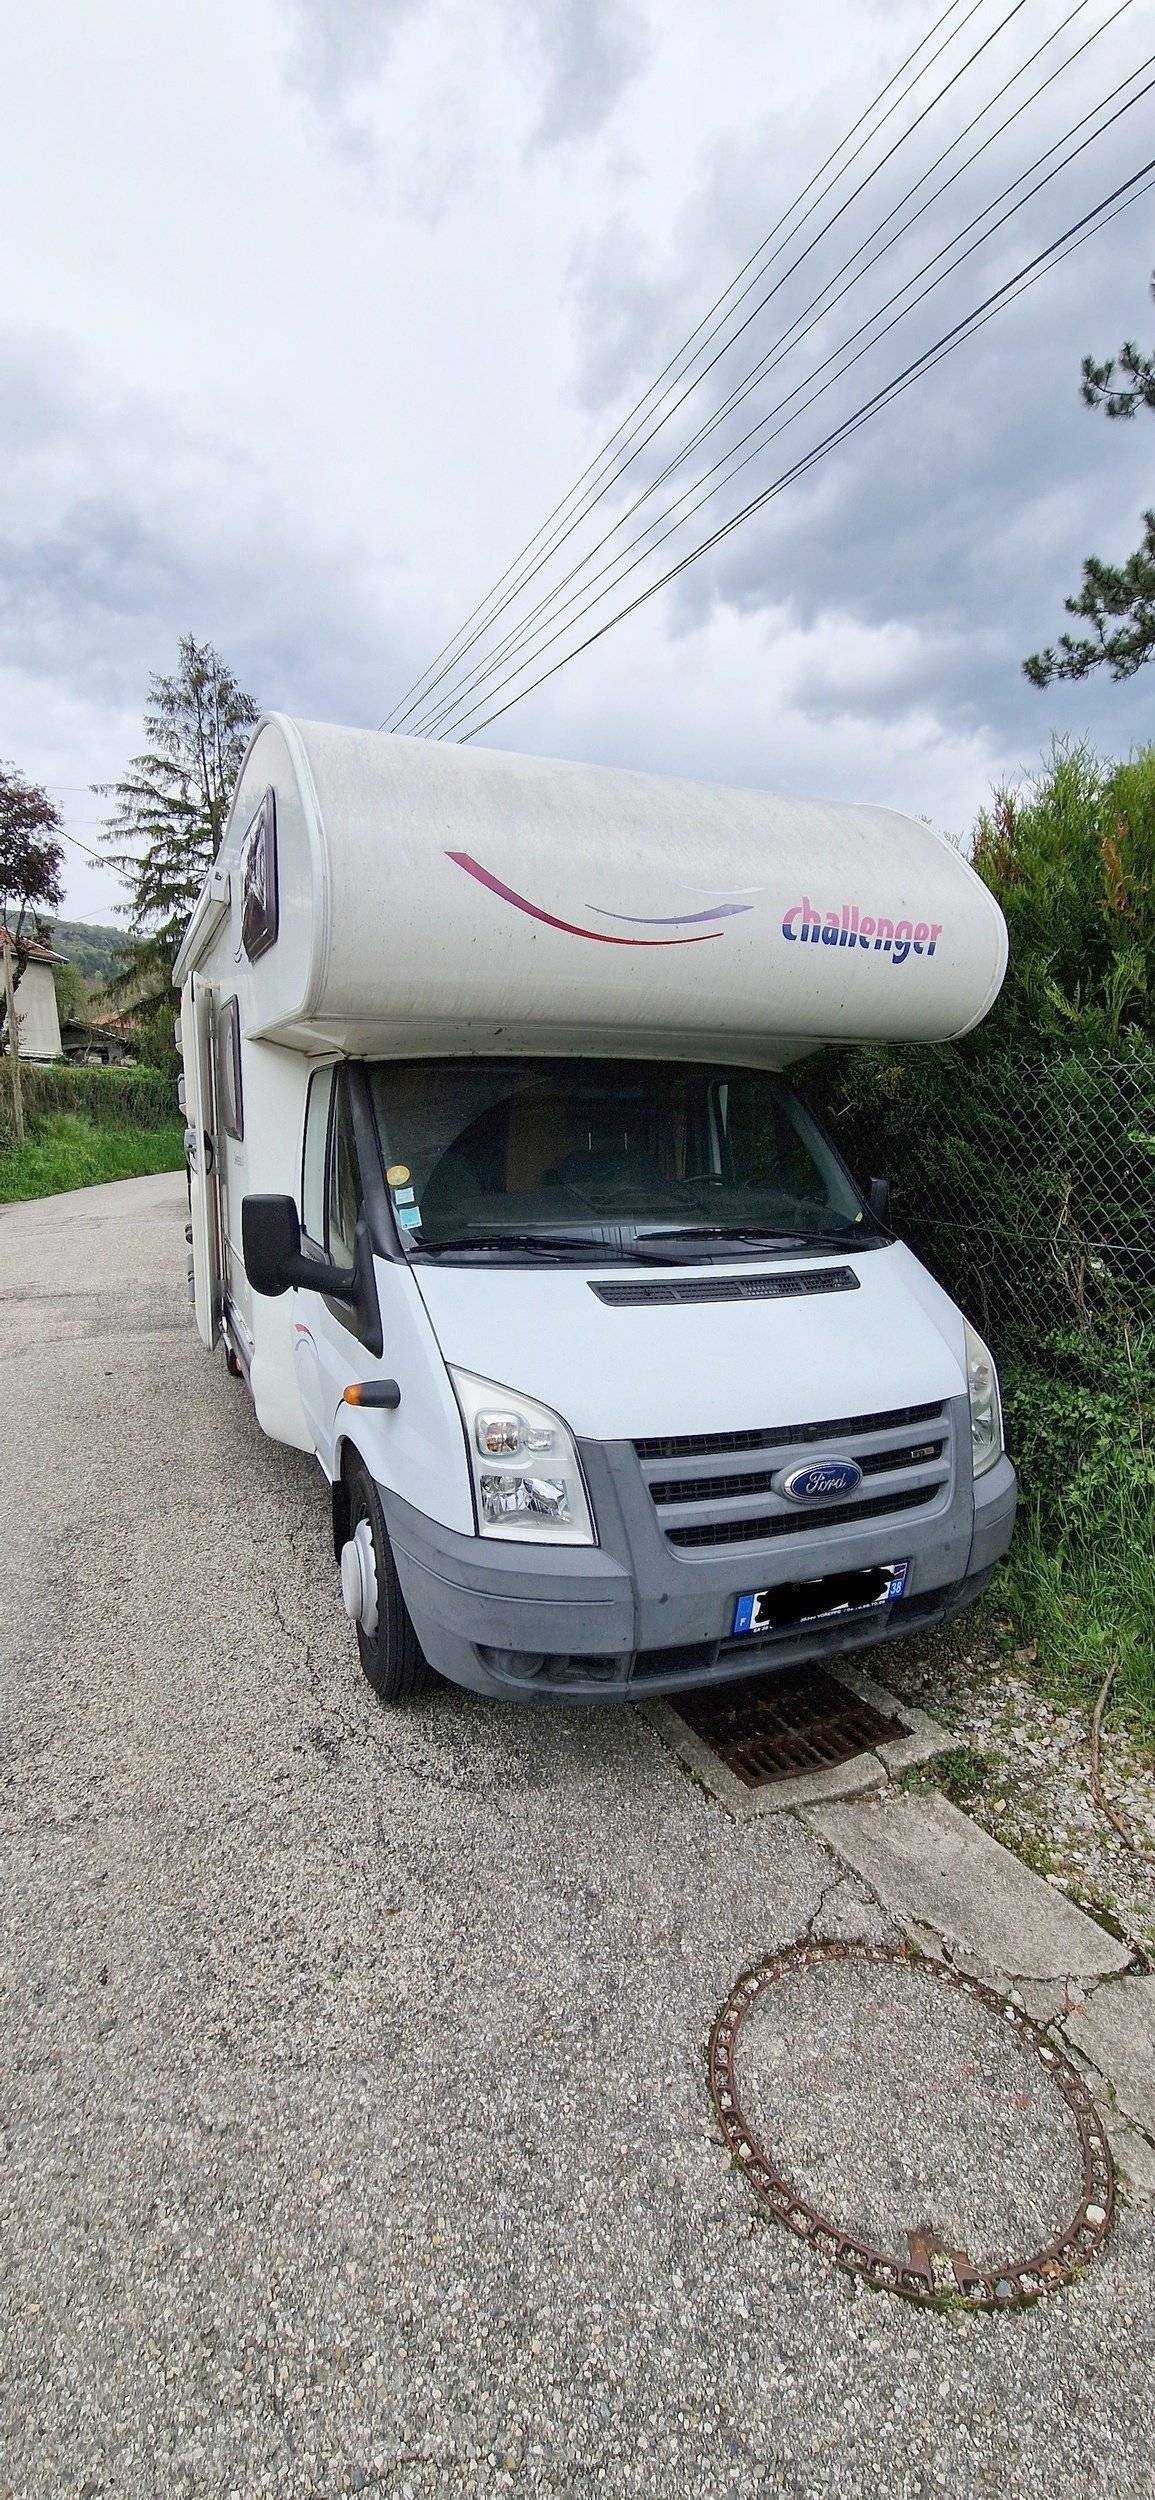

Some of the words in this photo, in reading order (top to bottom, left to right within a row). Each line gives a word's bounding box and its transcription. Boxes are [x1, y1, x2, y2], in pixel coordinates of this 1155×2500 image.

[782, 895, 943, 964] challenger
[805, 1469, 847, 1494] Ford
[890, 1581, 902, 1595] 38
[739, 1617, 746, 1627] F
